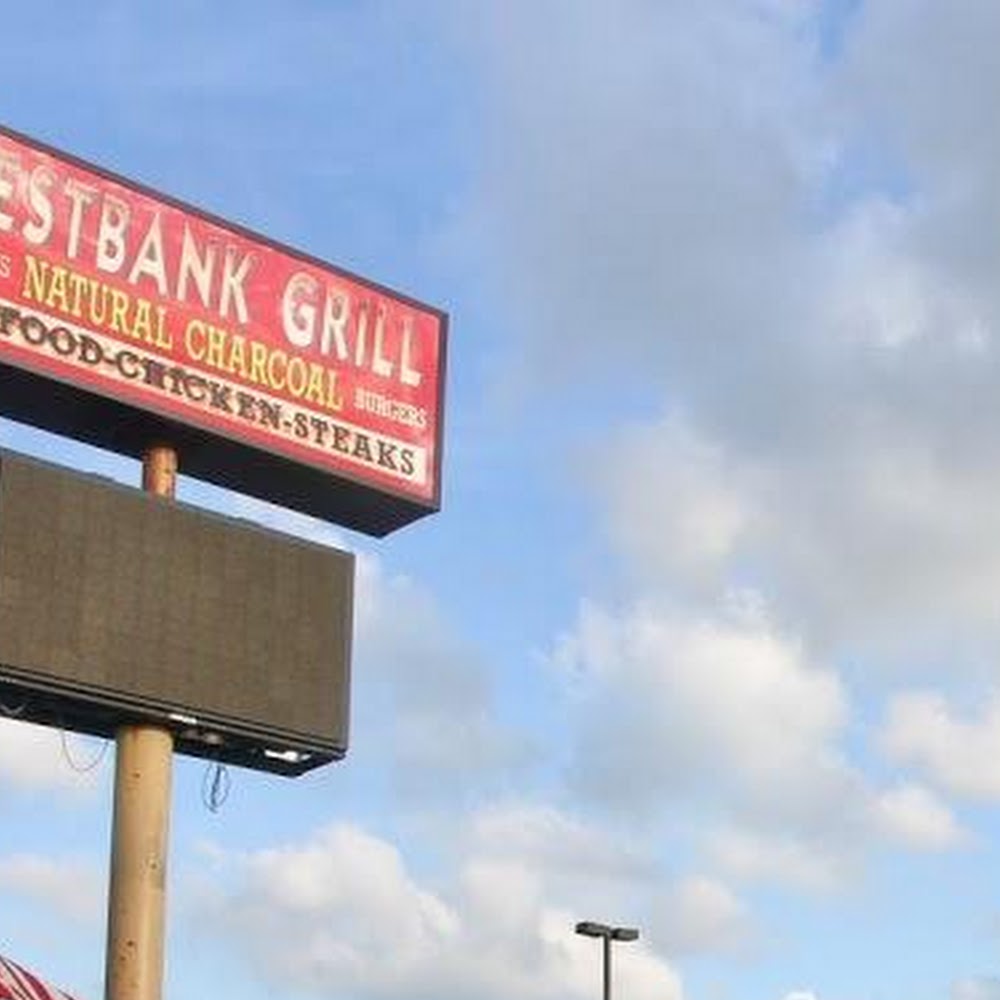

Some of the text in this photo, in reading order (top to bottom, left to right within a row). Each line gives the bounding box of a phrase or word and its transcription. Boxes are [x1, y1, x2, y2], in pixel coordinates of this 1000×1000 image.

[22, 254, 173, 351] NATURAL
[185, 318, 344, 412] CHARCOAL
[281, 271, 423, 388] GRILL
